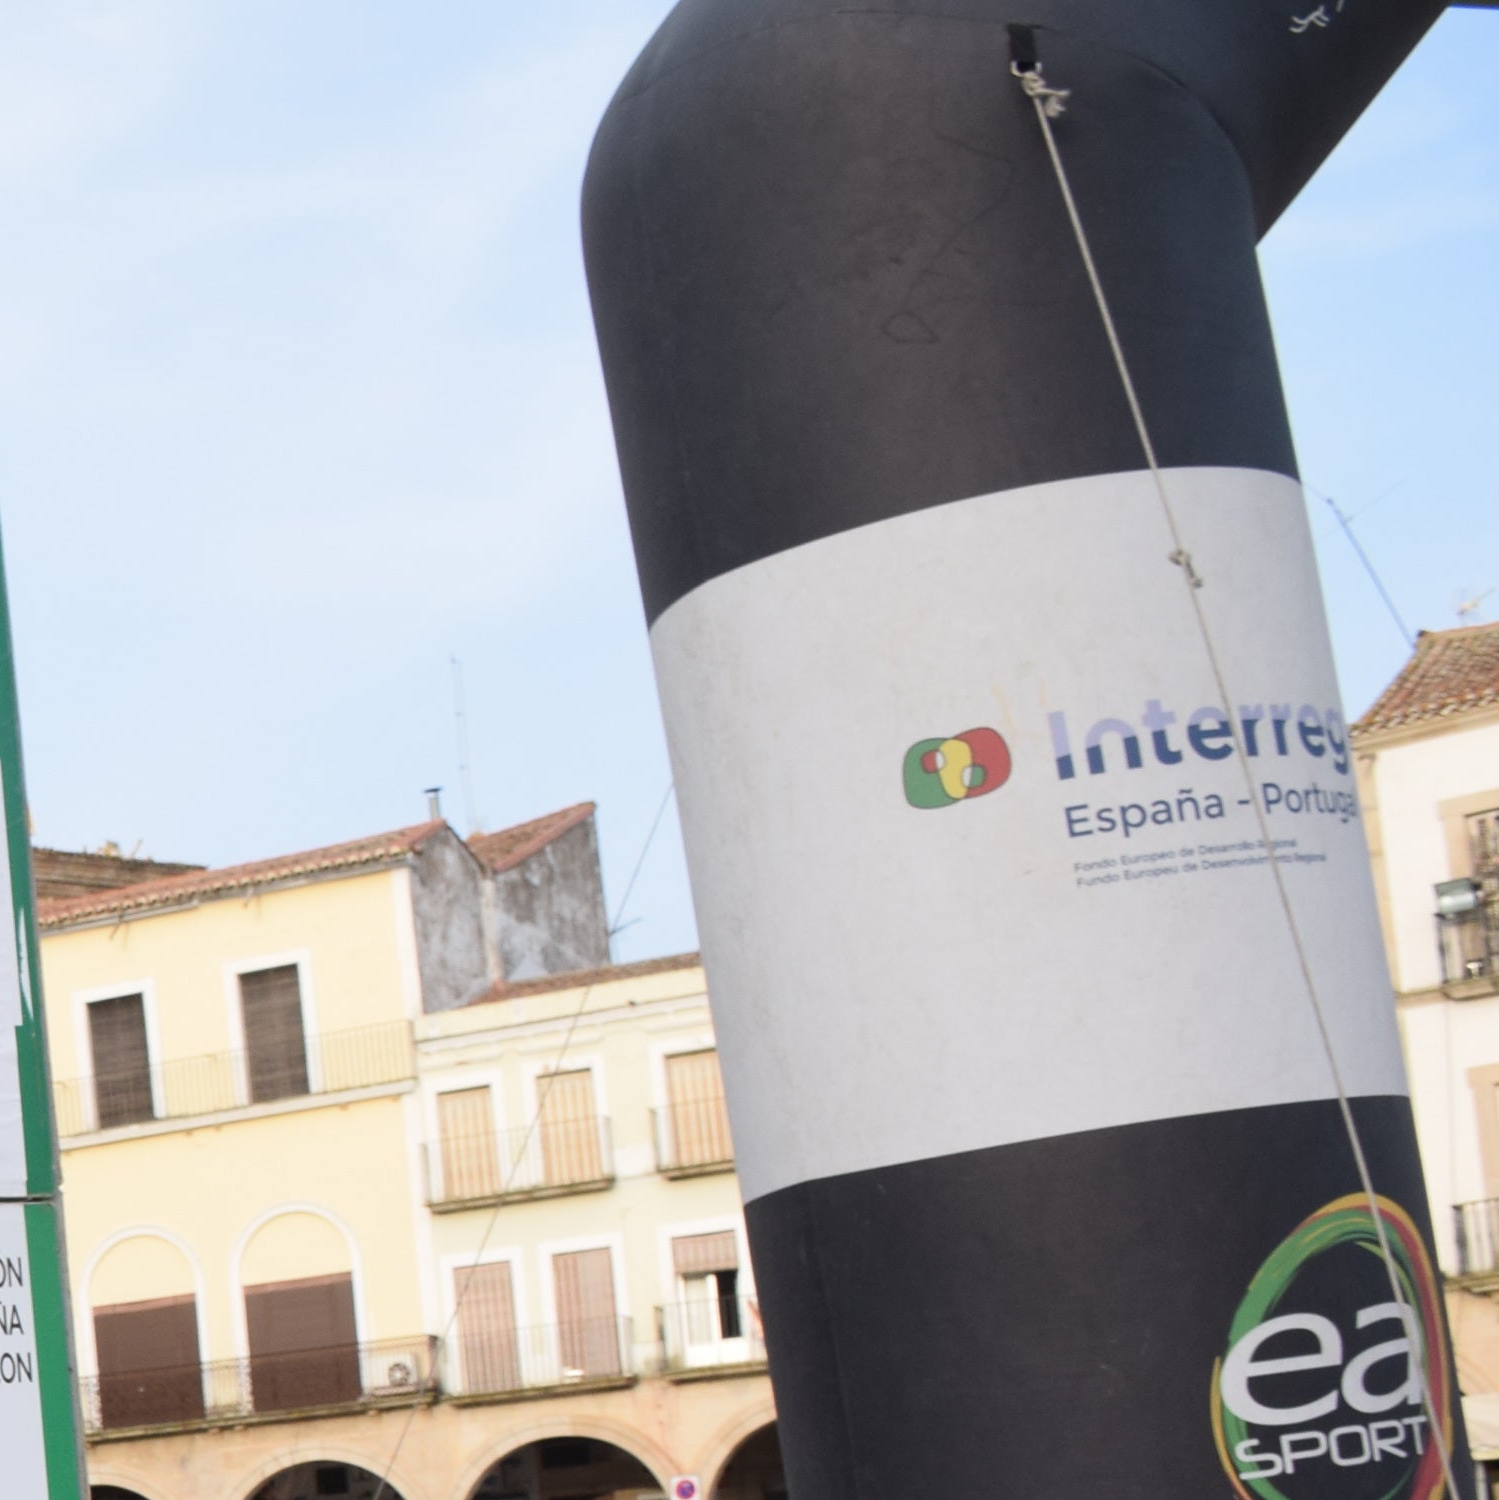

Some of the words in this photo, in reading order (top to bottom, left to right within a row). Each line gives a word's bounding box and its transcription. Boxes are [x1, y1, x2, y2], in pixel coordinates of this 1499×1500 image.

[1047, 699, 1350, 781] Interreg
[1065, 788, 1225, 838] España
[1221, 1301, 1425, 1426] ea
